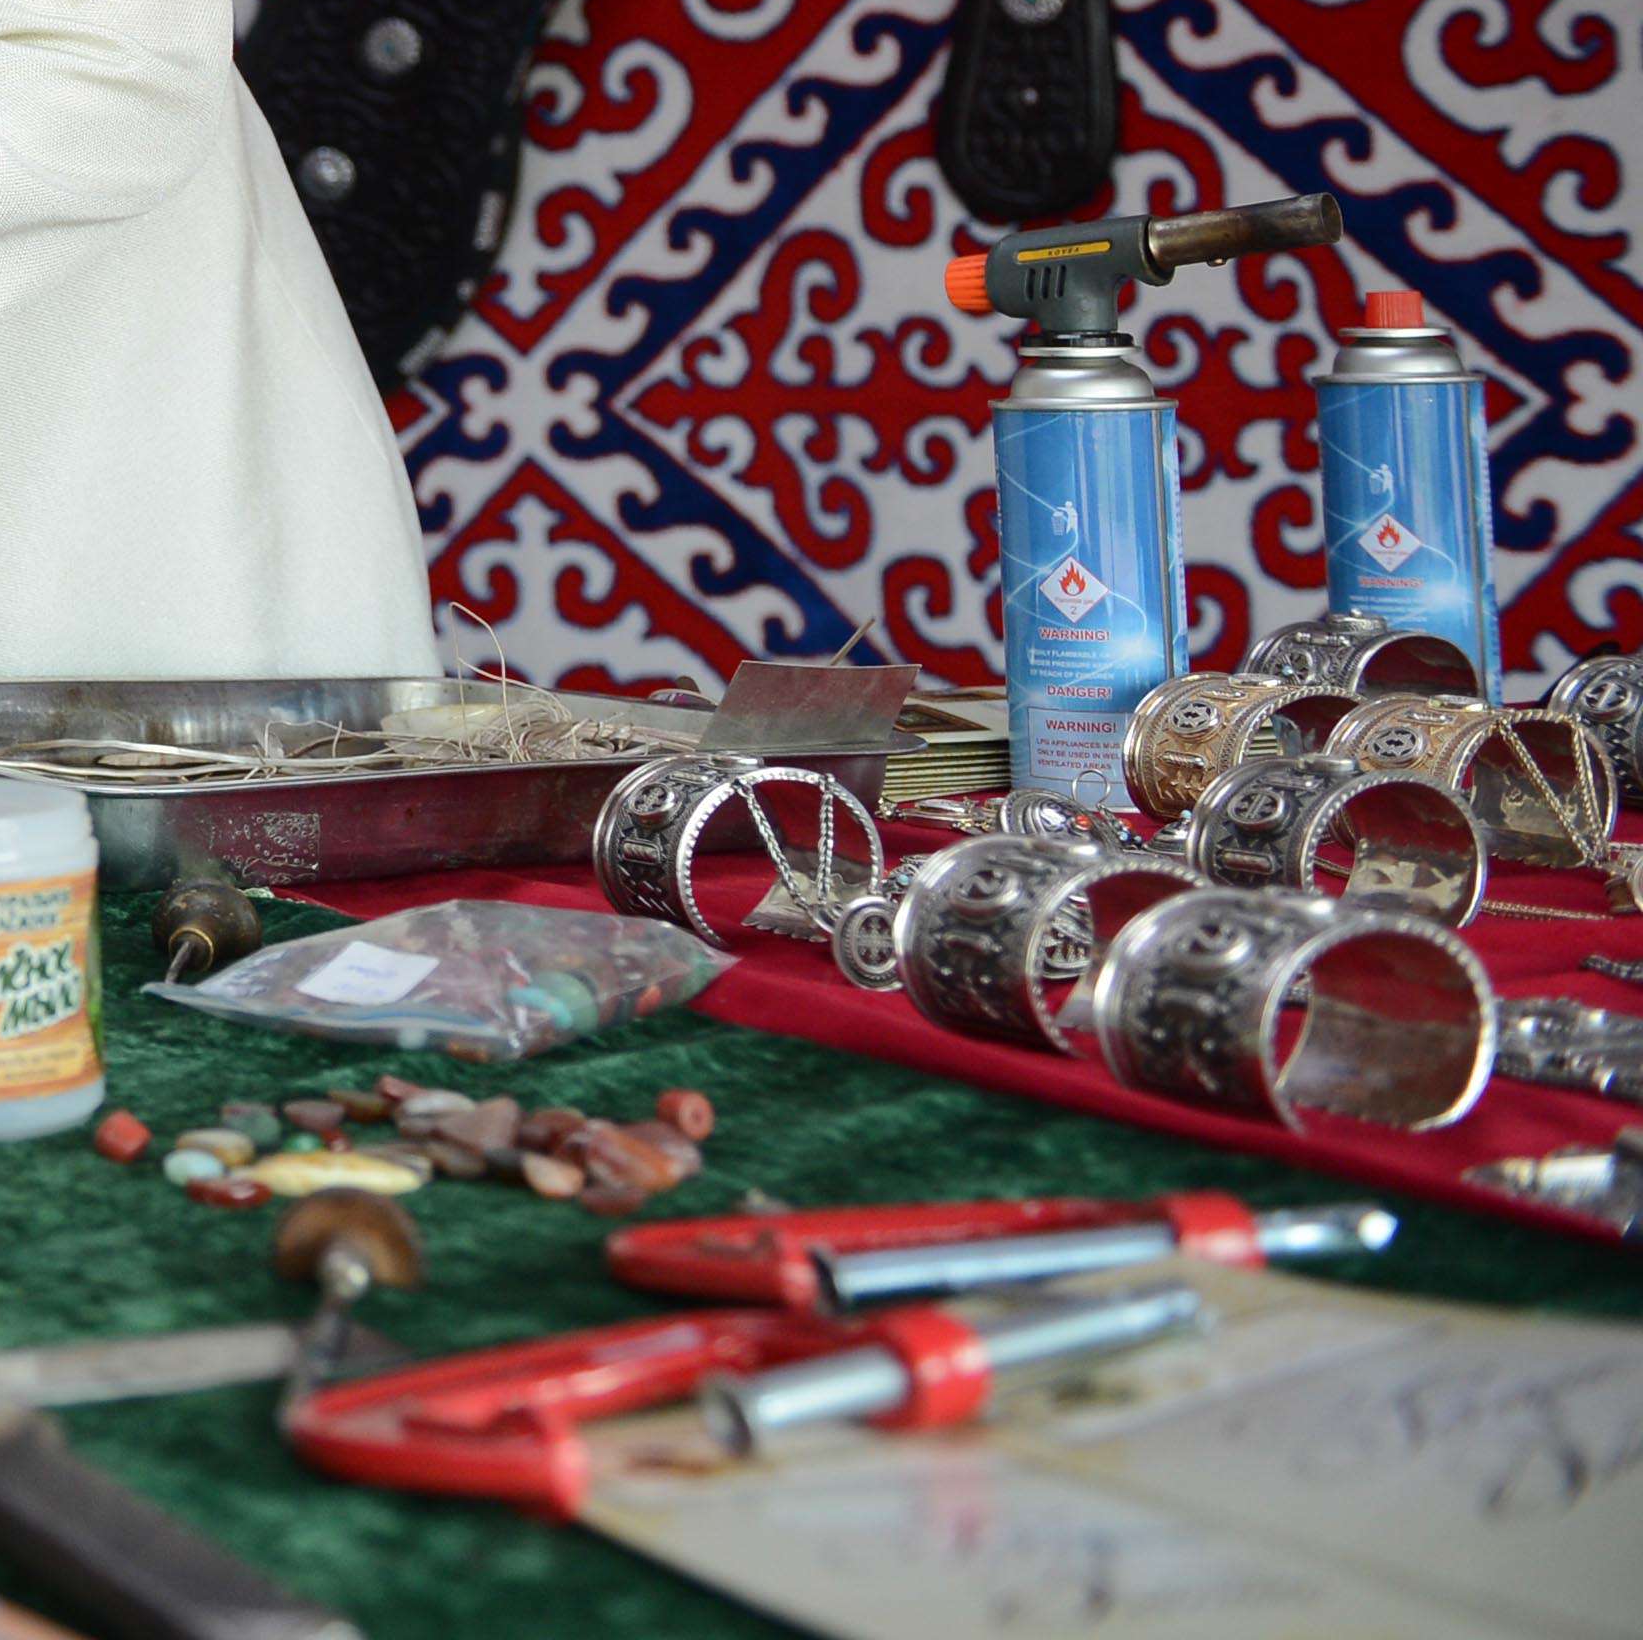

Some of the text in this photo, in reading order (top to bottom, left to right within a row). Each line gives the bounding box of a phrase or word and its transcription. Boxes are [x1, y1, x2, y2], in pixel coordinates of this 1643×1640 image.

[1048, 247, 1080, 256] KOVEA
[1070, 606, 1077, 615] 2
[1039, 627, 1110, 642] WARNING!
[1047, 685, 1112, 698] DANGER!
[1046, 720, 1117, 734] WARNING!
[1068, 751, 1091, 759] USED
